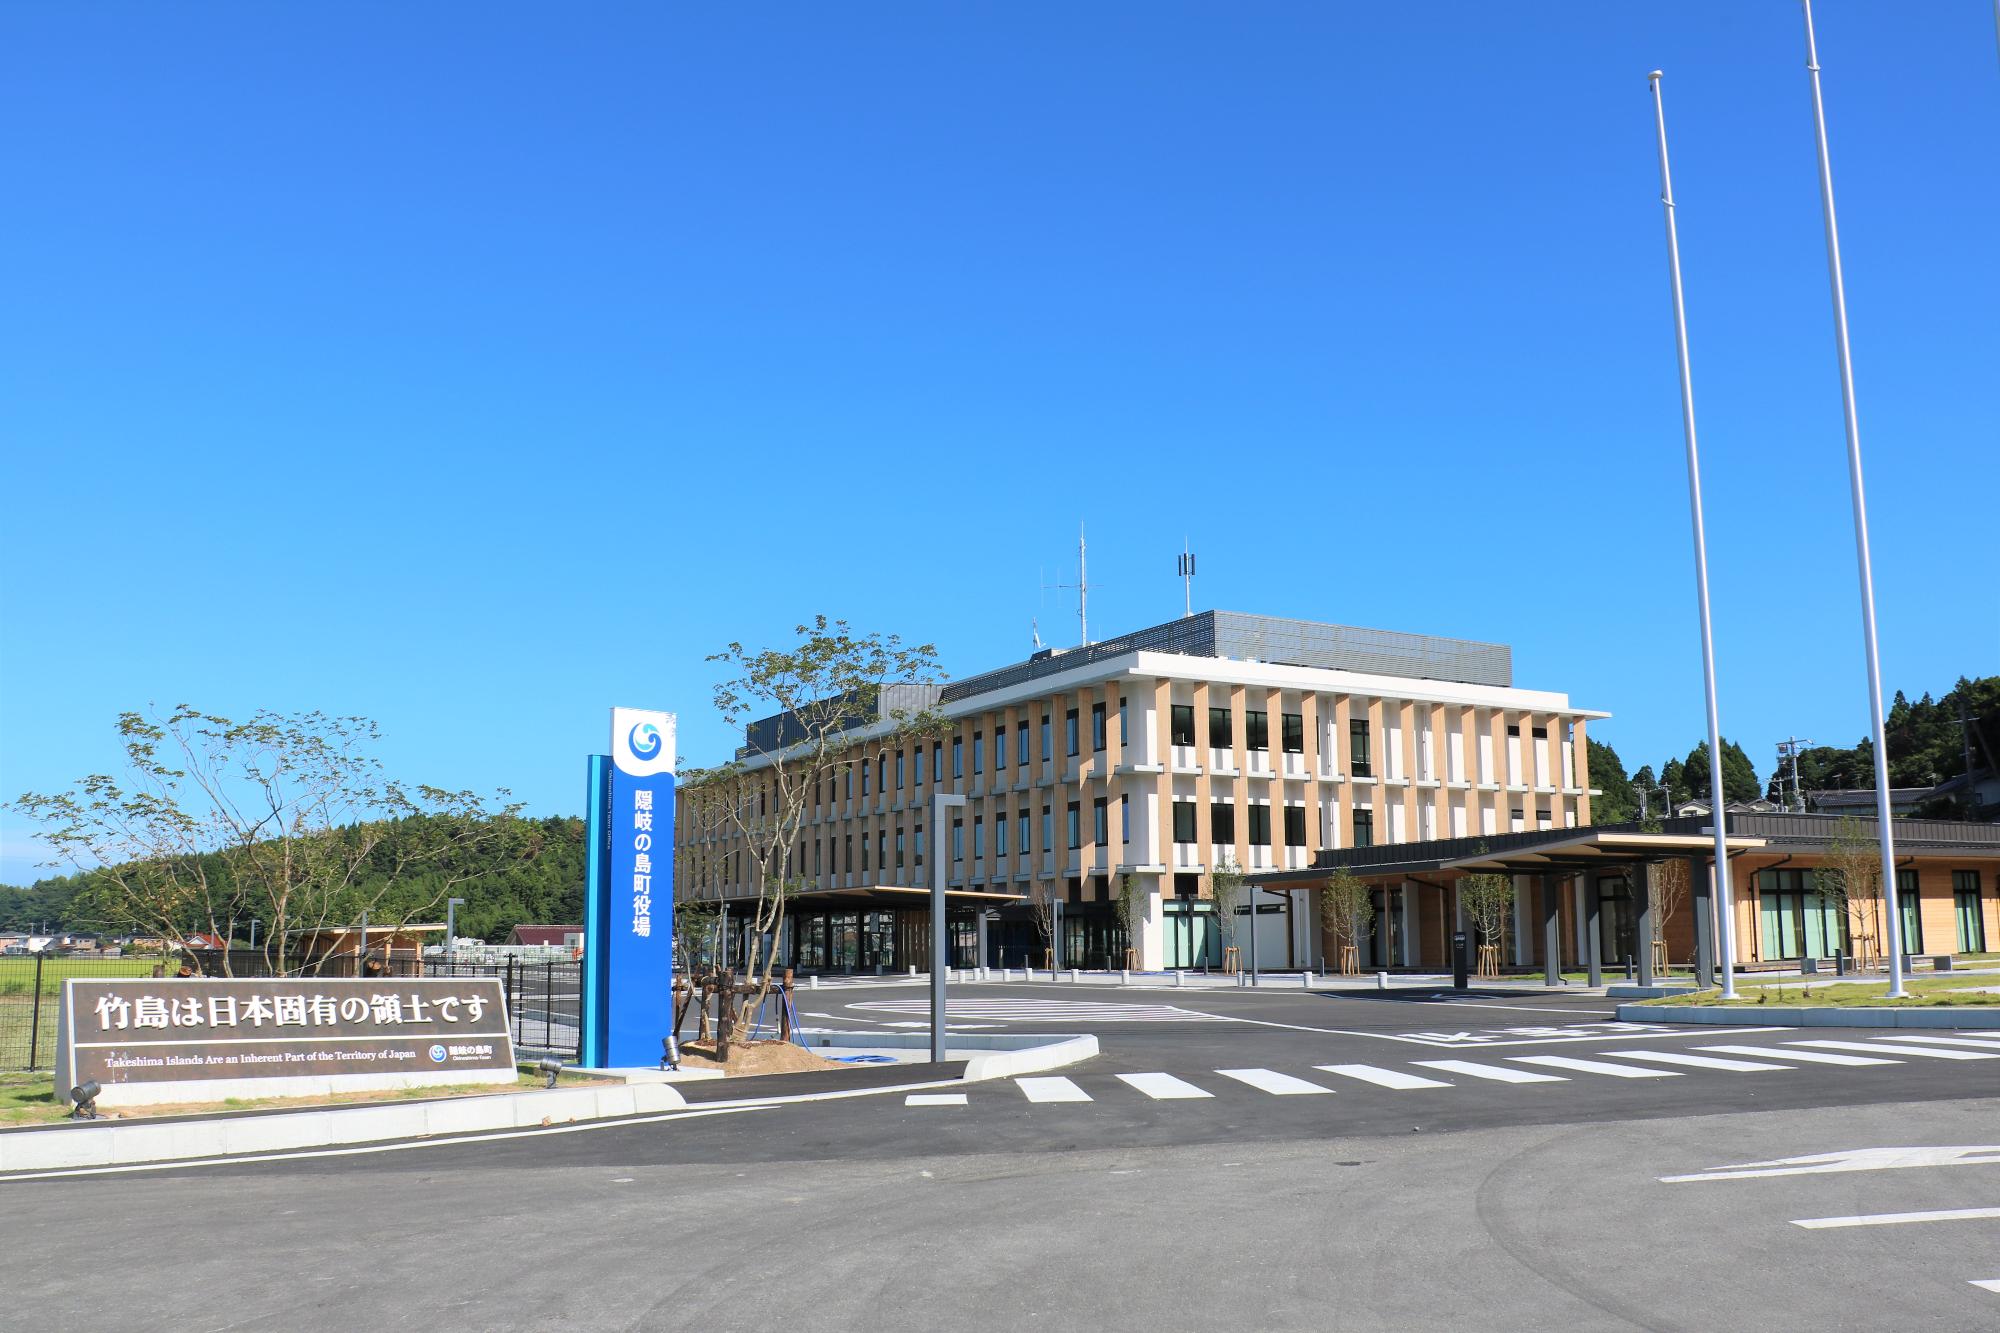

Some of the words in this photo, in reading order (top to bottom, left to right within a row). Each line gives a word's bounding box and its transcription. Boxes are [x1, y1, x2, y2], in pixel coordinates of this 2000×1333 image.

[632, 790, 653, 938] 隠岐の島町役場
[95, 994, 489, 1031] 竹島は日本固有の領土です
[105, 1056, 163, 1068] Takeshima
[166, 1055, 203, 1066] Islands
[205, 1055, 223, 1065] Are
[225, 1056, 239, 1064] an
[241, 1053, 283, 1064] Inherent
[285, 1053, 306, 1062] Part
[307, 1052, 317, 1061] of
[318, 1051, 334, 1061] the
[334, 1051, 376, 1062] Territory
[377, 1050, 388, 1059] of
[388, 1050, 416, 1060] Japan
